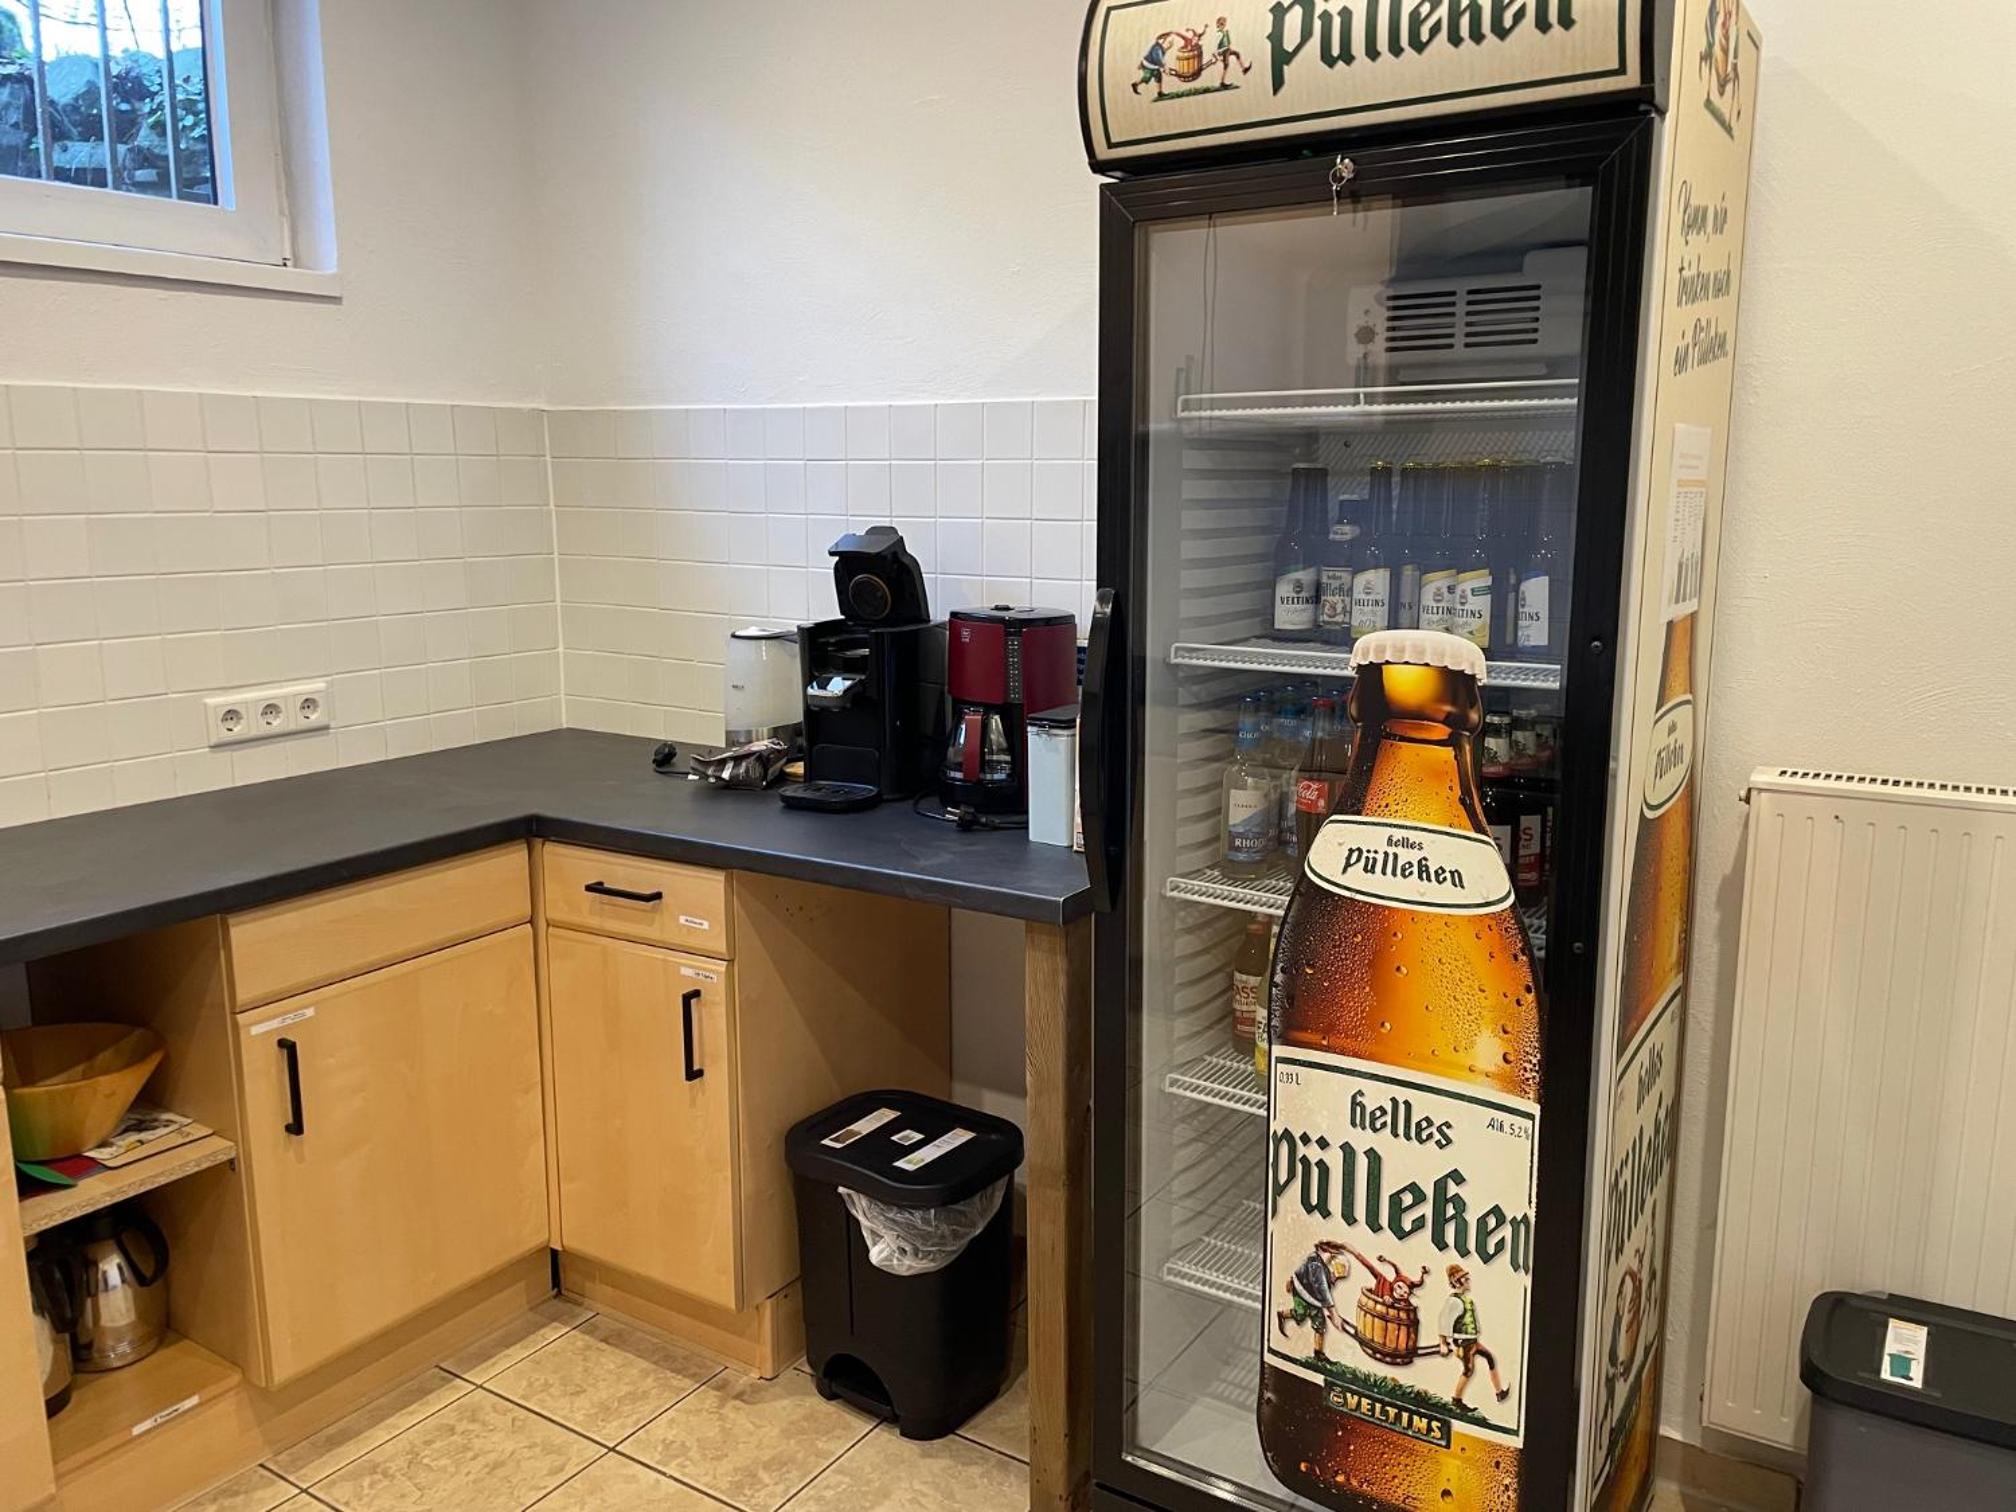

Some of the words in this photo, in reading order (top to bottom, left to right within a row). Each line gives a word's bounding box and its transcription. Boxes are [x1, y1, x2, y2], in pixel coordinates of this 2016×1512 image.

[1421, 603, 1453, 617] VELTIN
[1386, 834, 1424, 852] helles
[1349, 1088, 1454, 1151] helles
[1345, 1391, 1443, 1441] VELTINS
